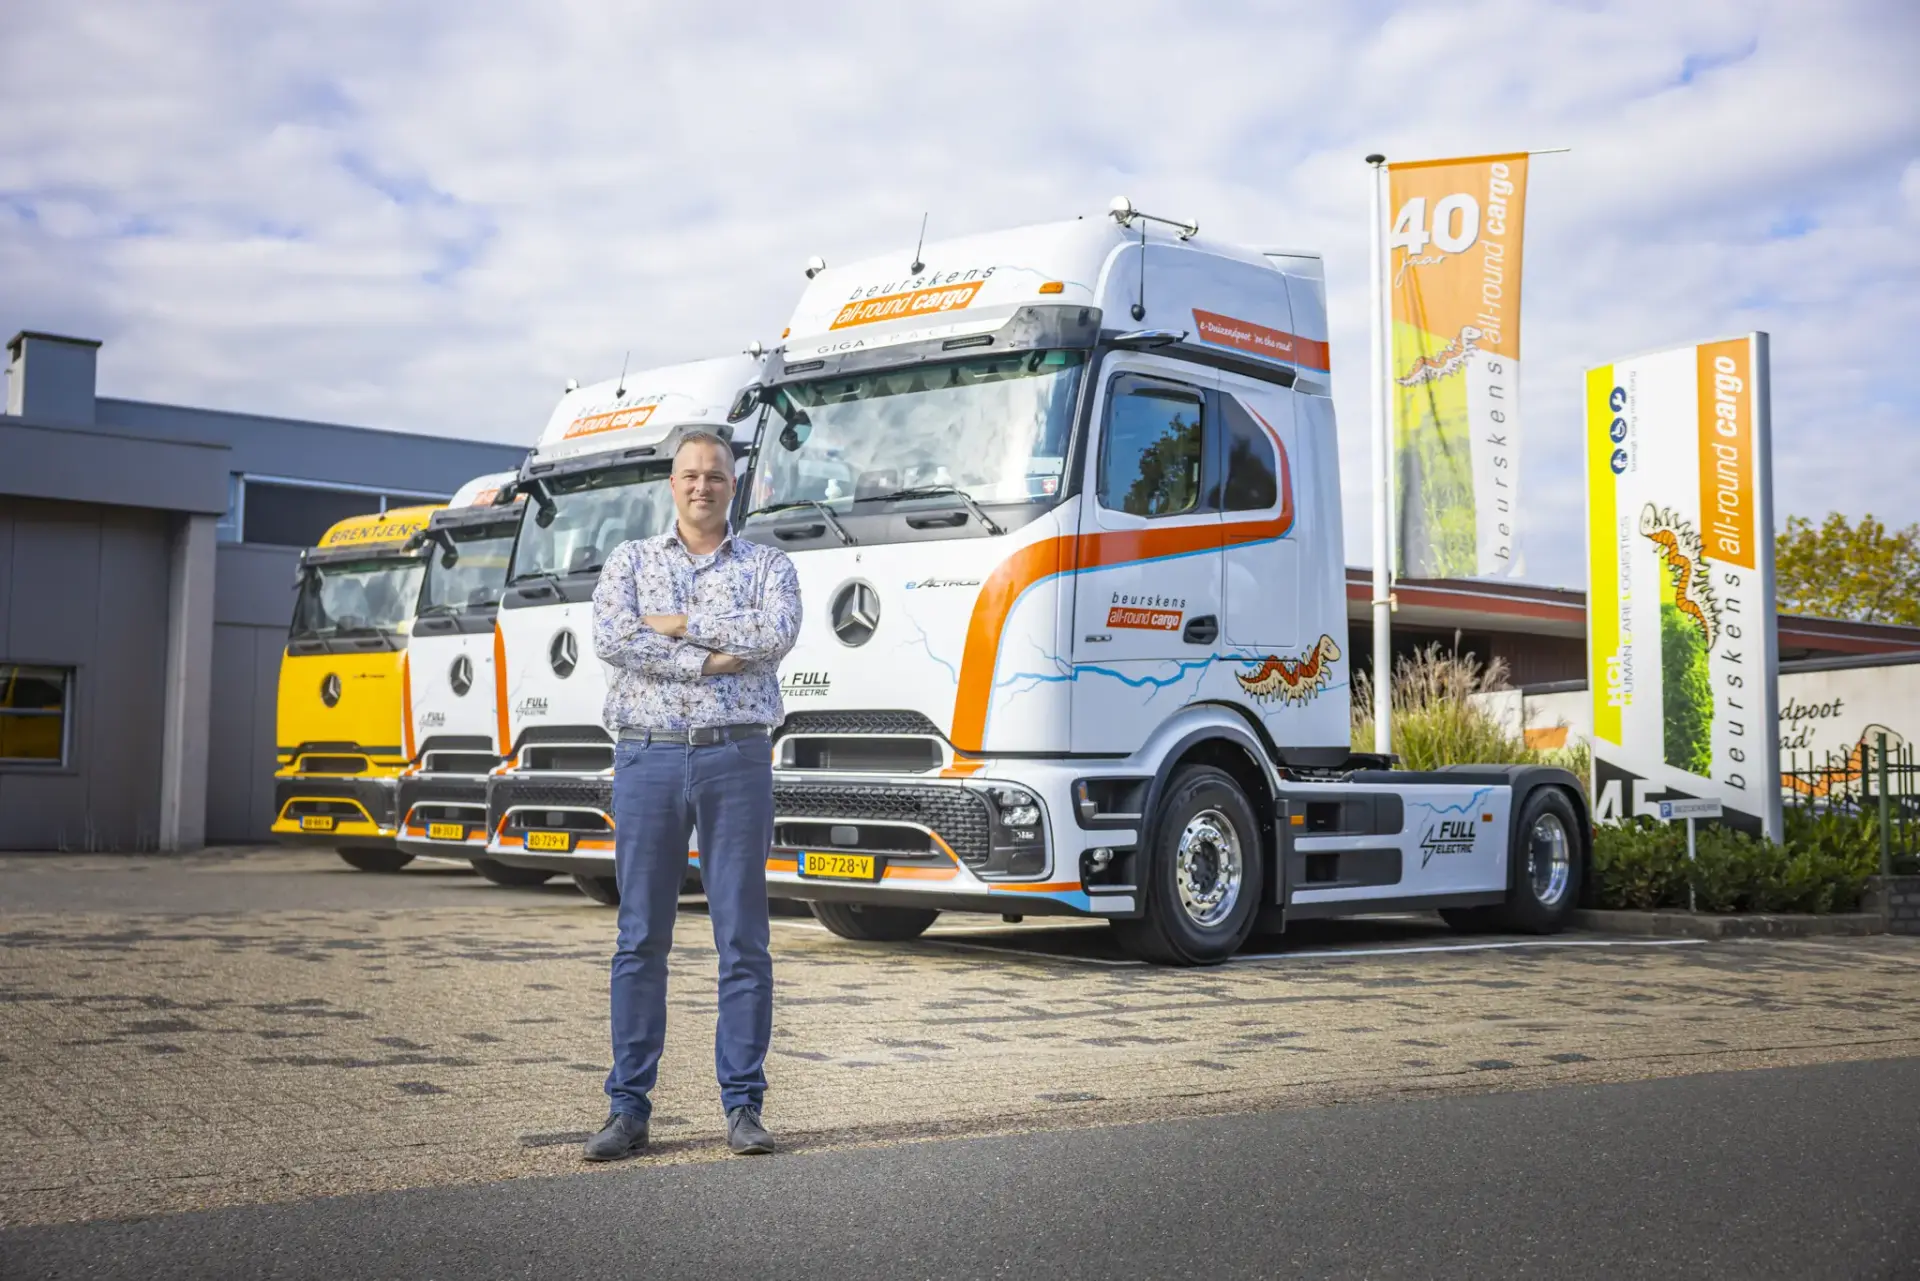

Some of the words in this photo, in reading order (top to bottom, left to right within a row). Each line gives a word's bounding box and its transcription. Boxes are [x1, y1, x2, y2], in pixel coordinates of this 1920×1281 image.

[1487, 163, 1514, 236] cargo
[1391, 193, 1480, 255] 40
[850, 265, 996, 300] beurskens
[1395, 255, 1447, 289] jaar
[836, 292, 914, 325] all-round
[911, 287, 974, 311] cargo
[1477, 240, 1504, 345] all-round
[817, 340, 865, 354] GIGA
[1714, 356, 1743, 438] cargo
[1711, 442, 1741, 555] all-round
[1111, 591, 1186, 608] beurskens
[1109, 608, 1152, 625] all-round
[1151, 613, 1180, 629] cargo
[792, 672, 831, 685] FULL
[1606, 647, 1621, 707] HCL
[1720, 573, 1746, 791] beurskens
[525, 697, 549, 709] FULL
[789, 688, 829, 697] ELECTRIC
[426, 711, 446, 722] FULL
[1439, 821, 1476, 838] FULL
[1435, 843, 1474, 854] ELECTRIC
[809, 856, 868, 874] BD-728-V
